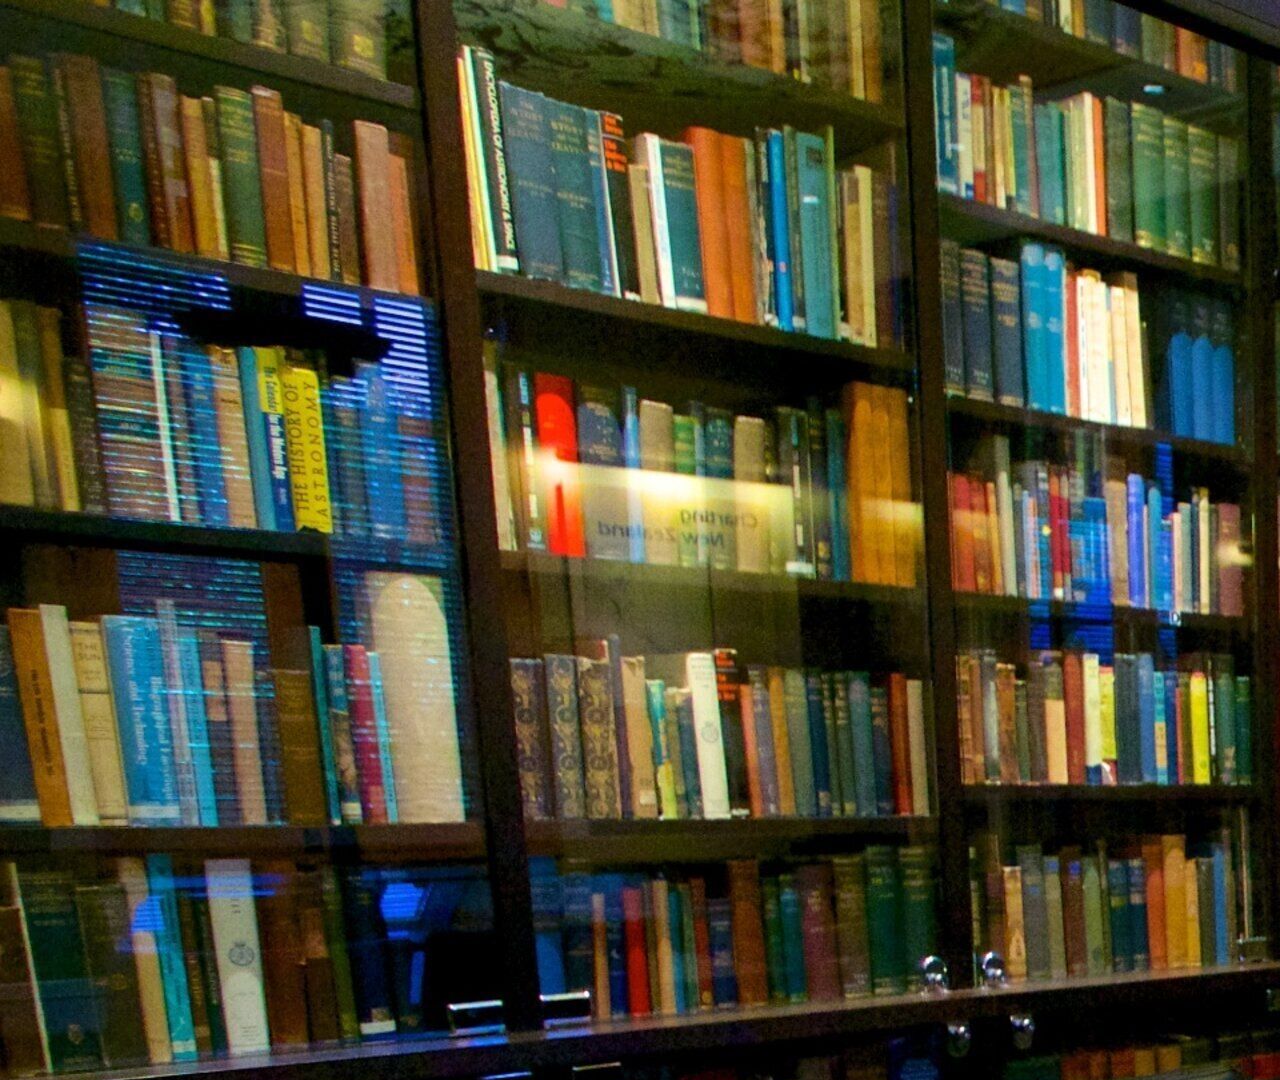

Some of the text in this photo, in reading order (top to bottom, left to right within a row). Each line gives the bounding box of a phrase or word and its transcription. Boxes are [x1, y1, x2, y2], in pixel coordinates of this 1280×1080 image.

[493, 134, 503, 150] OF
[495, 150, 511, 212] ASTRONOMY
[503, 221, 515, 250] SPACE
[265, 380, 278, 411] Calendar
[269, 414, 283, 424] for
[270, 425, 284, 437] the
[271, 438, 286, 464] Modern
[284, 384, 310, 512] THE HISTORY OF
[303, 382, 329, 517] ASTRONOMY
[272, 466, 288, 479] Age
[150, 676, 170, 744] Biographical
[132, 706, 149, 766] Technology
